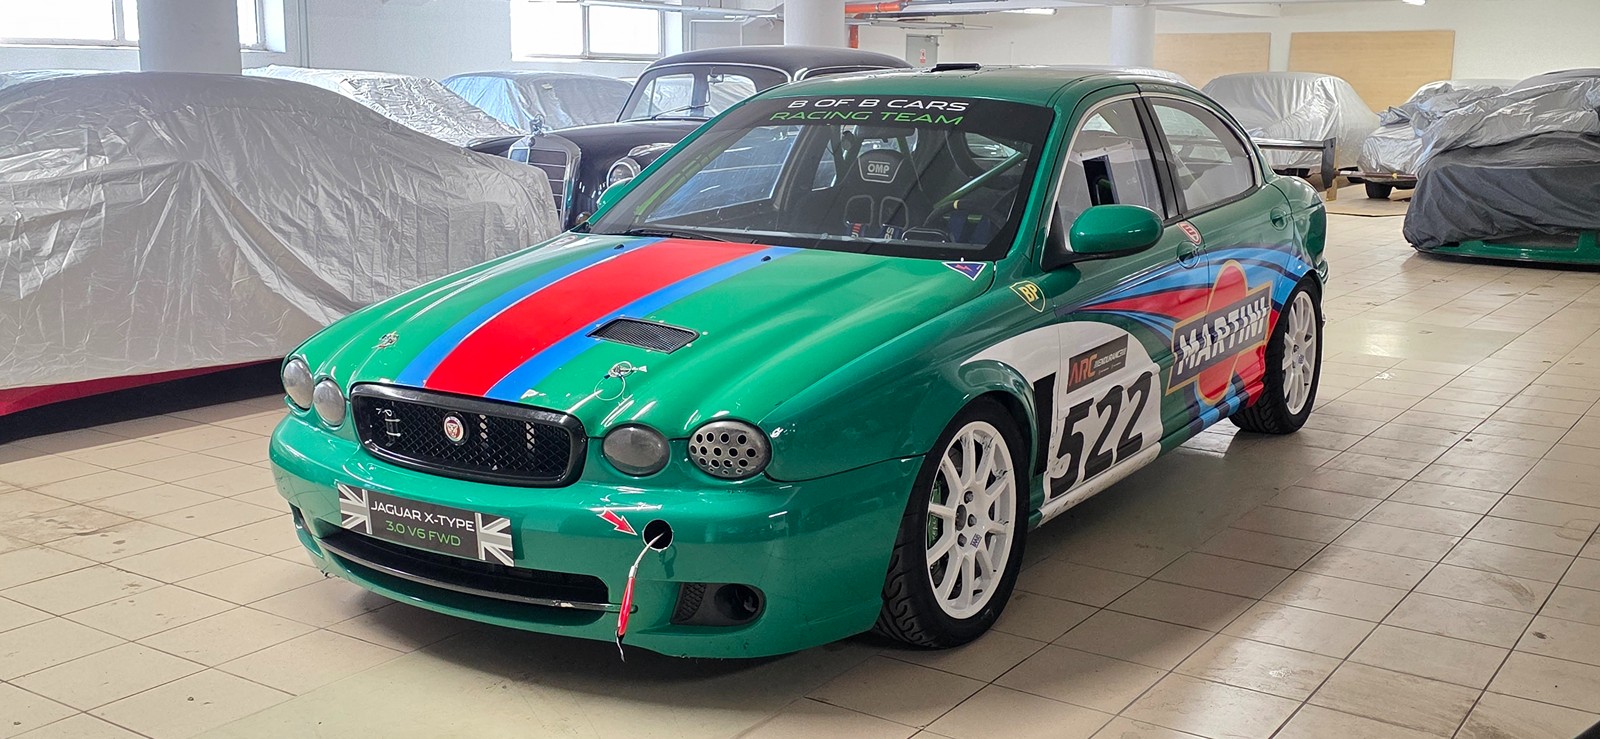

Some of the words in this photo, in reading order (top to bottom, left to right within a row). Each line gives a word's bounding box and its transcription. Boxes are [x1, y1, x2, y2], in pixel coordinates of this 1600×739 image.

[769, 111, 873, 121] RACING
[880, 111, 964, 125] TEAM
[787, 99, 807, 109] B
[814, 98, 855, 107] OF
[858, 98, 880, 108] B
[886, 99, 970, 112] CARS
[867, 163, 890, 174] OMP
[1018, 283, 1040, 303] BP
[1177, 296, 1268, 376] MARTINI
[1068, 353, 1098, 387] ARC
[1049, 370, 1153, 499] 522
[370, 500, 422, 522] JAGUAR
[424, 511, 475, 533] X-TYPE
[385, 520, 405, 534] 3.0
[407, 525, 426, 539] V6
[428, 530, 461, 547] FWD
